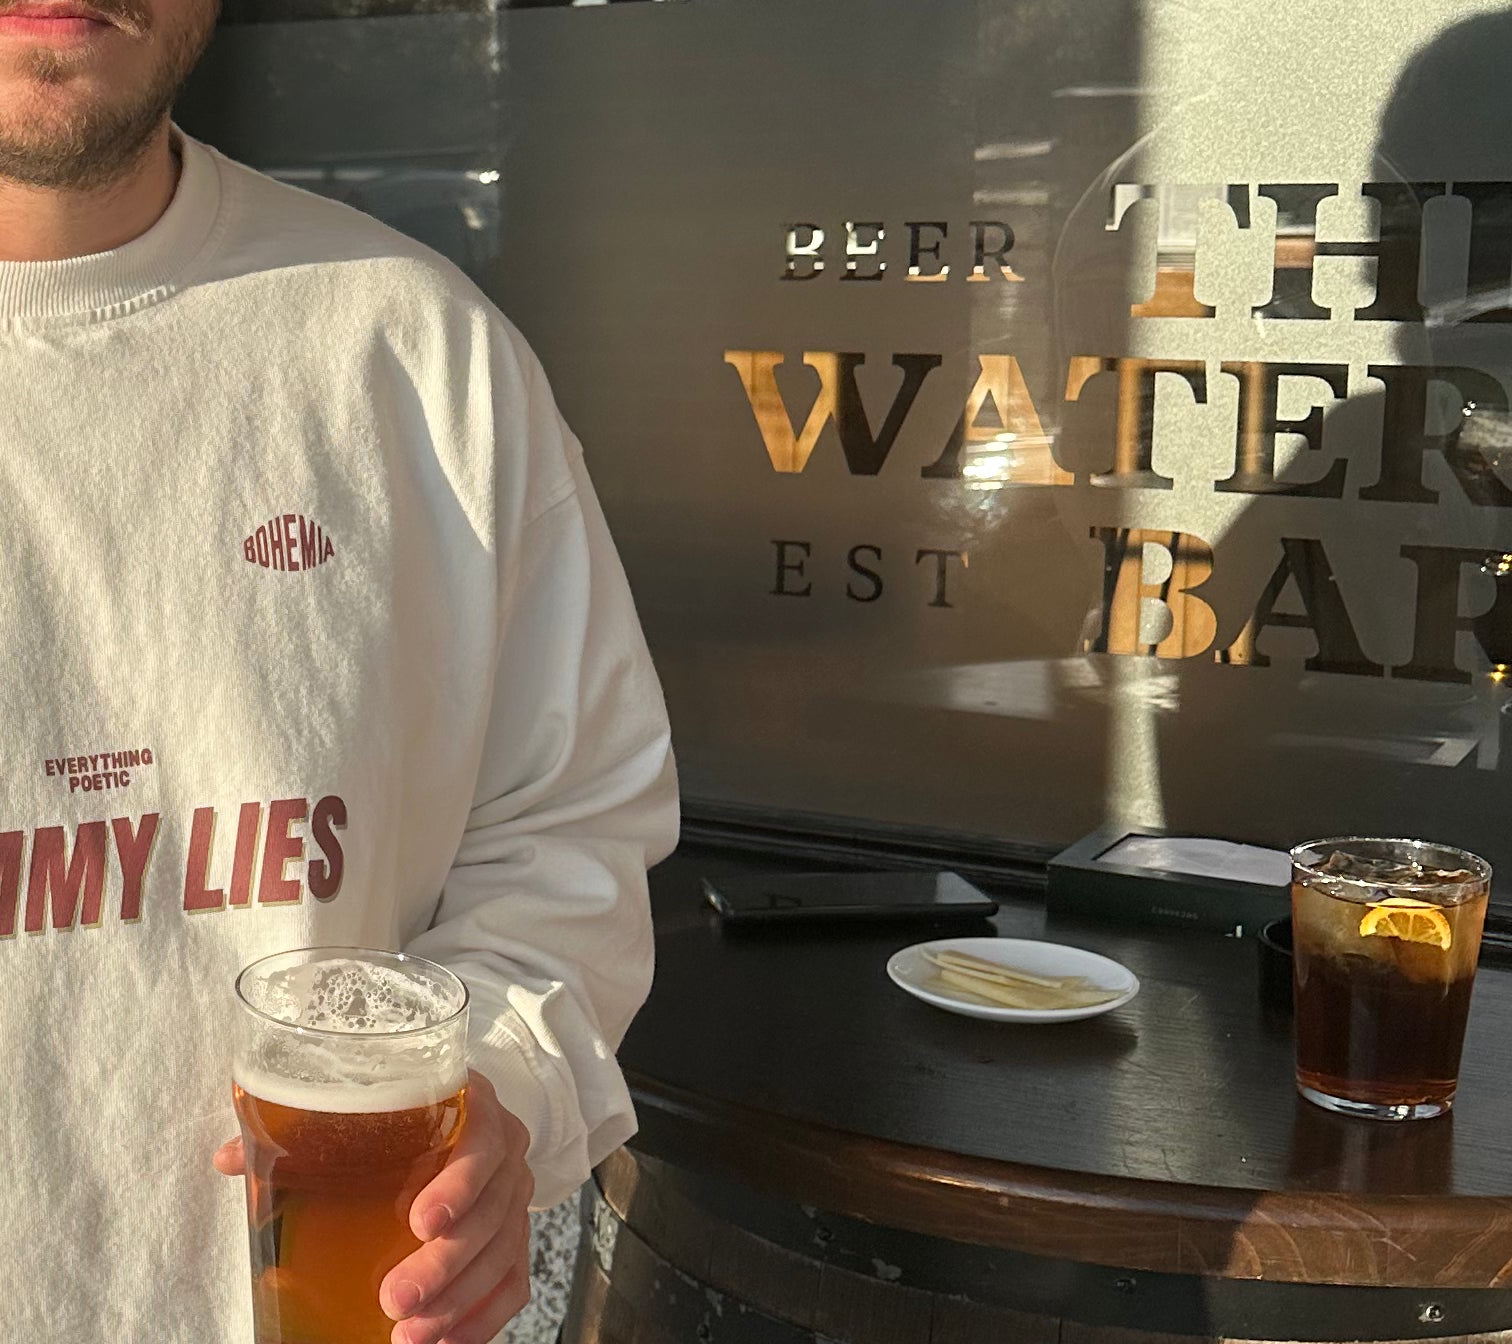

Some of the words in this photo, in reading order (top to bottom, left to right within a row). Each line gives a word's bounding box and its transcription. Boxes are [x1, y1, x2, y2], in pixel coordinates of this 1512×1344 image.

[779, 220, 1026, 282] BEER
[724, 350, 1512, 508] WATER
[242, 513, 336, 573] BOHEMIA
[769, 539, 970, 609] EST
[1084, 526, 1512, 690] BAR
[44, 747, 154, 778] EVERYTHING
[68, 770, 131, 794] POETIC
[183, 795, 348, 914] LIES
